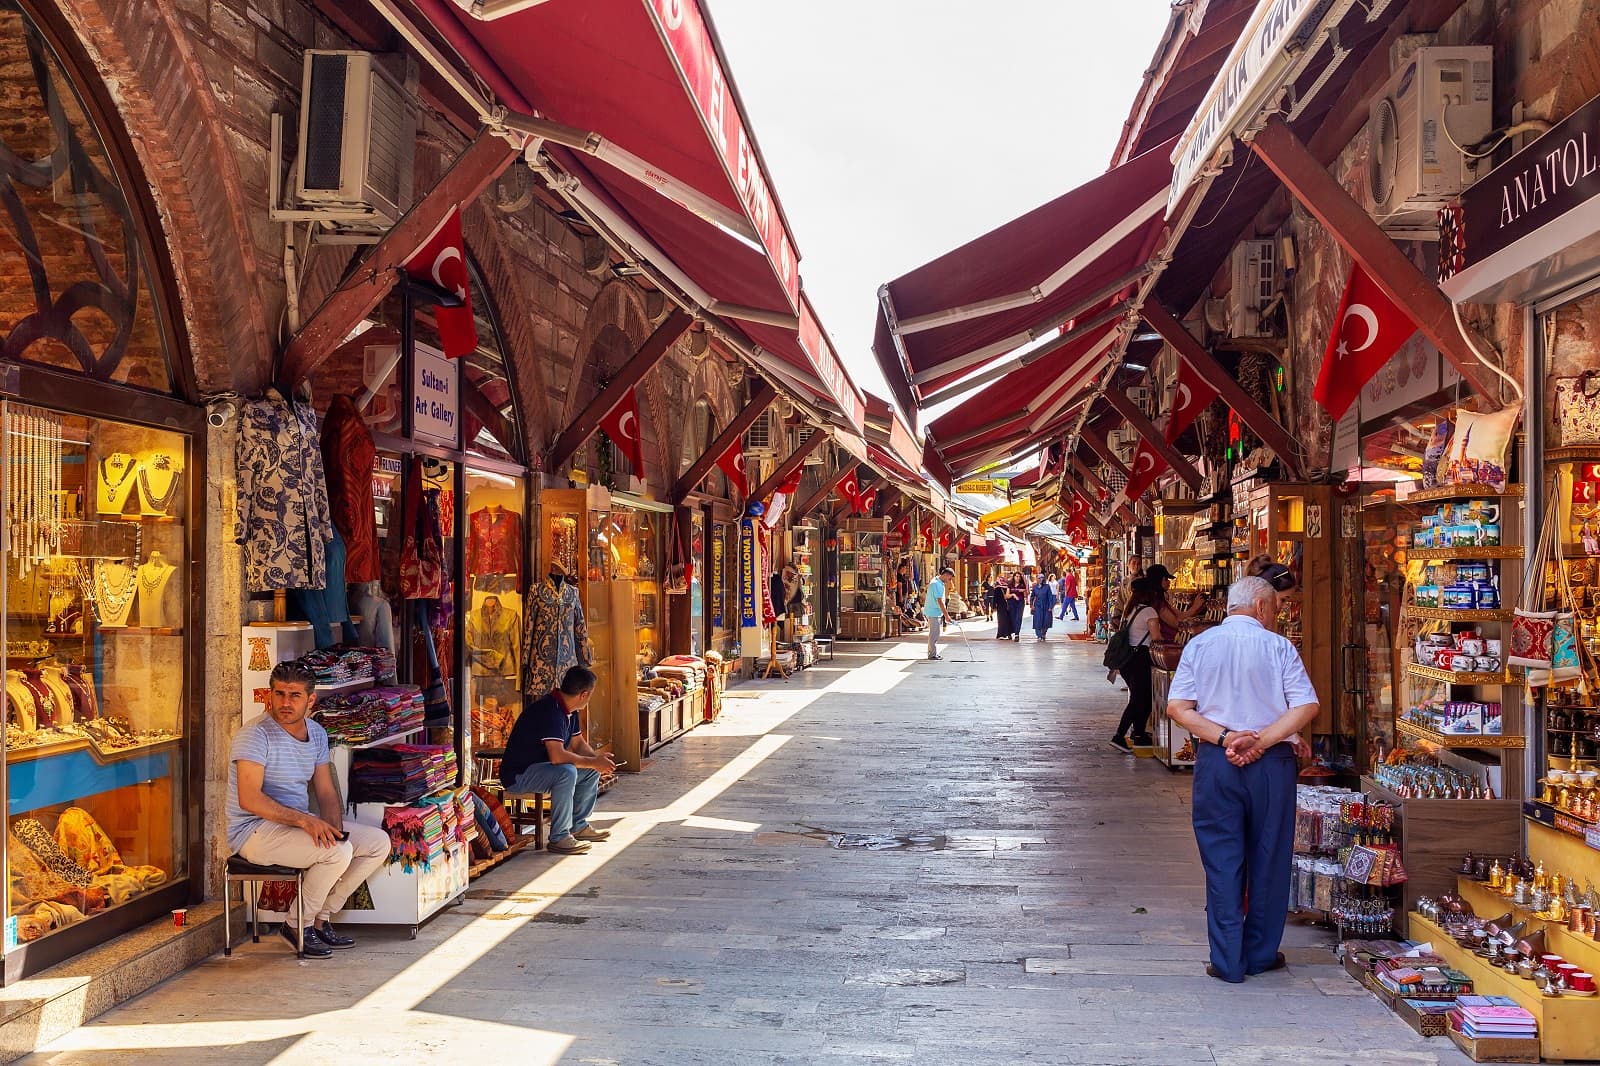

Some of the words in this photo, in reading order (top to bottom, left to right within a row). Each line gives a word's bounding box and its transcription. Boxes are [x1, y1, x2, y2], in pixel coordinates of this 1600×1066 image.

[710, 55, 727, 156] EL
[1500, 131, 1600, 229] ANATOL
[416, 396, 428, 416] Art
[431, 401, 455, 427] Gallery
[743, 538, 752, 595] BARCELONA
[744, 596, 752, 608] FC
